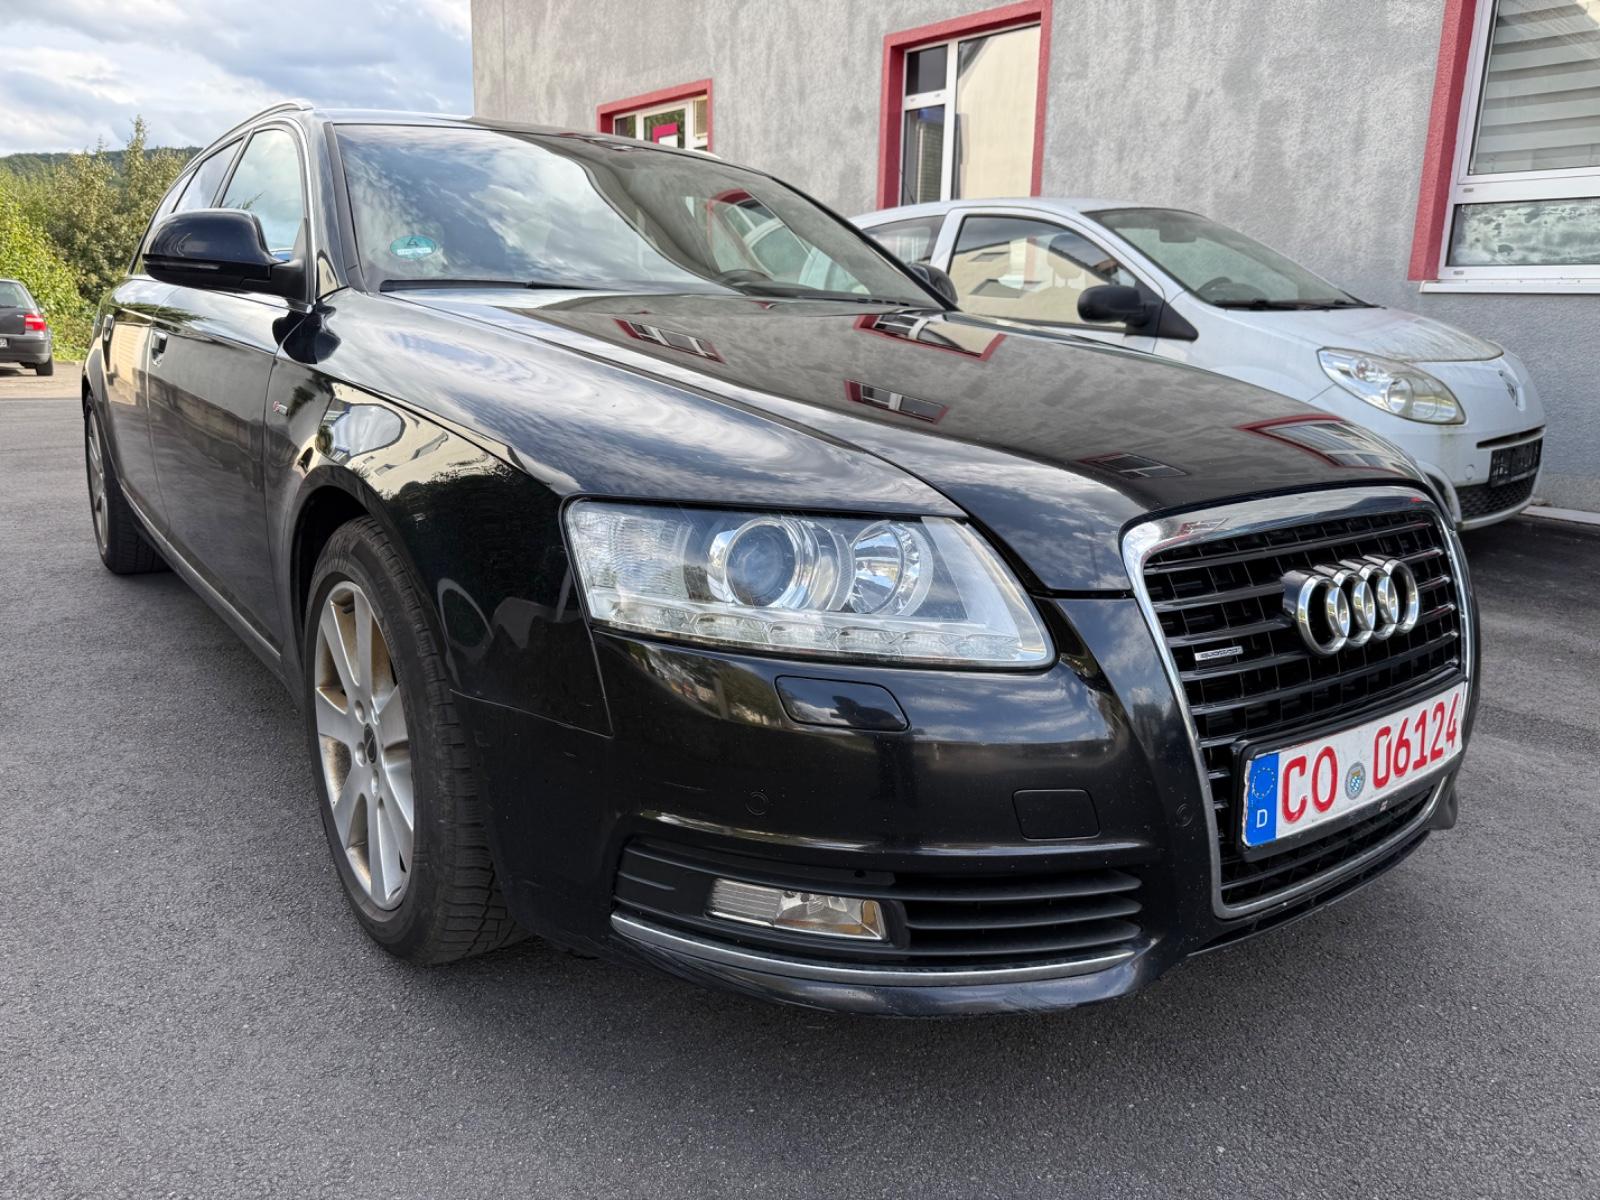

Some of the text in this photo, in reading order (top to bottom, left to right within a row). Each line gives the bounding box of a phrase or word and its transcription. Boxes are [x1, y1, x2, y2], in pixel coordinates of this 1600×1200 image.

[1281, 692, 1460, 823] CO 06124
[1256, 808, 1268, 828] D
